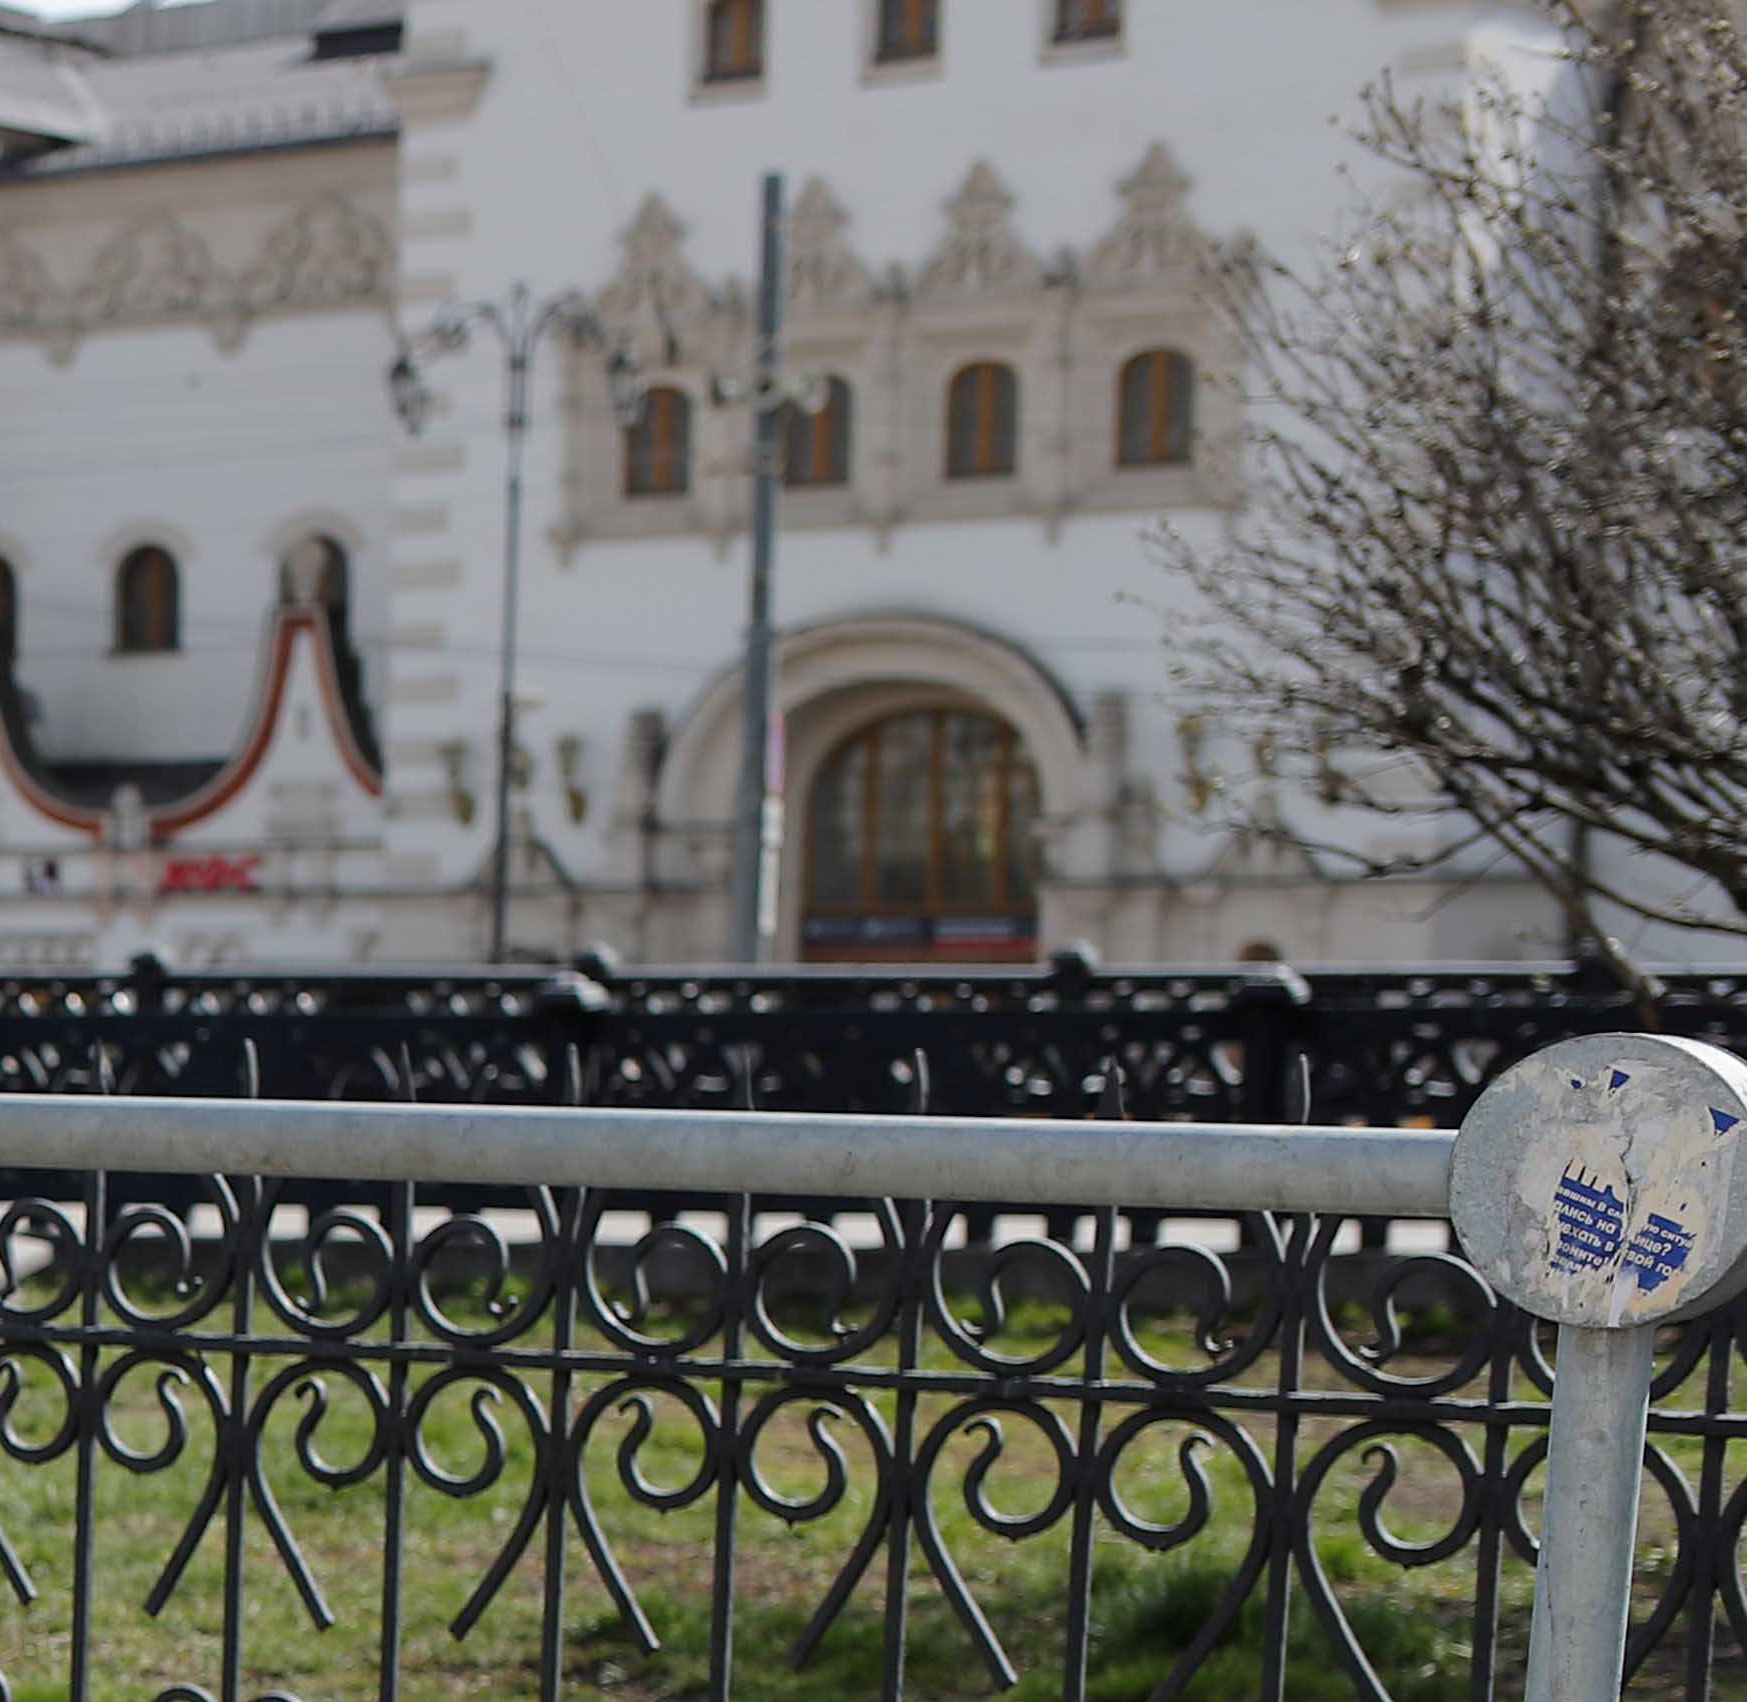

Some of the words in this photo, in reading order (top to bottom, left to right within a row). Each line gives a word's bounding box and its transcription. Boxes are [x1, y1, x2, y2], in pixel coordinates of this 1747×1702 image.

[1596, 1218, 1617, 1235] на
[1623, 1250, 1654, 1269] вой
[1655, 1262, 1674, 1277] го
